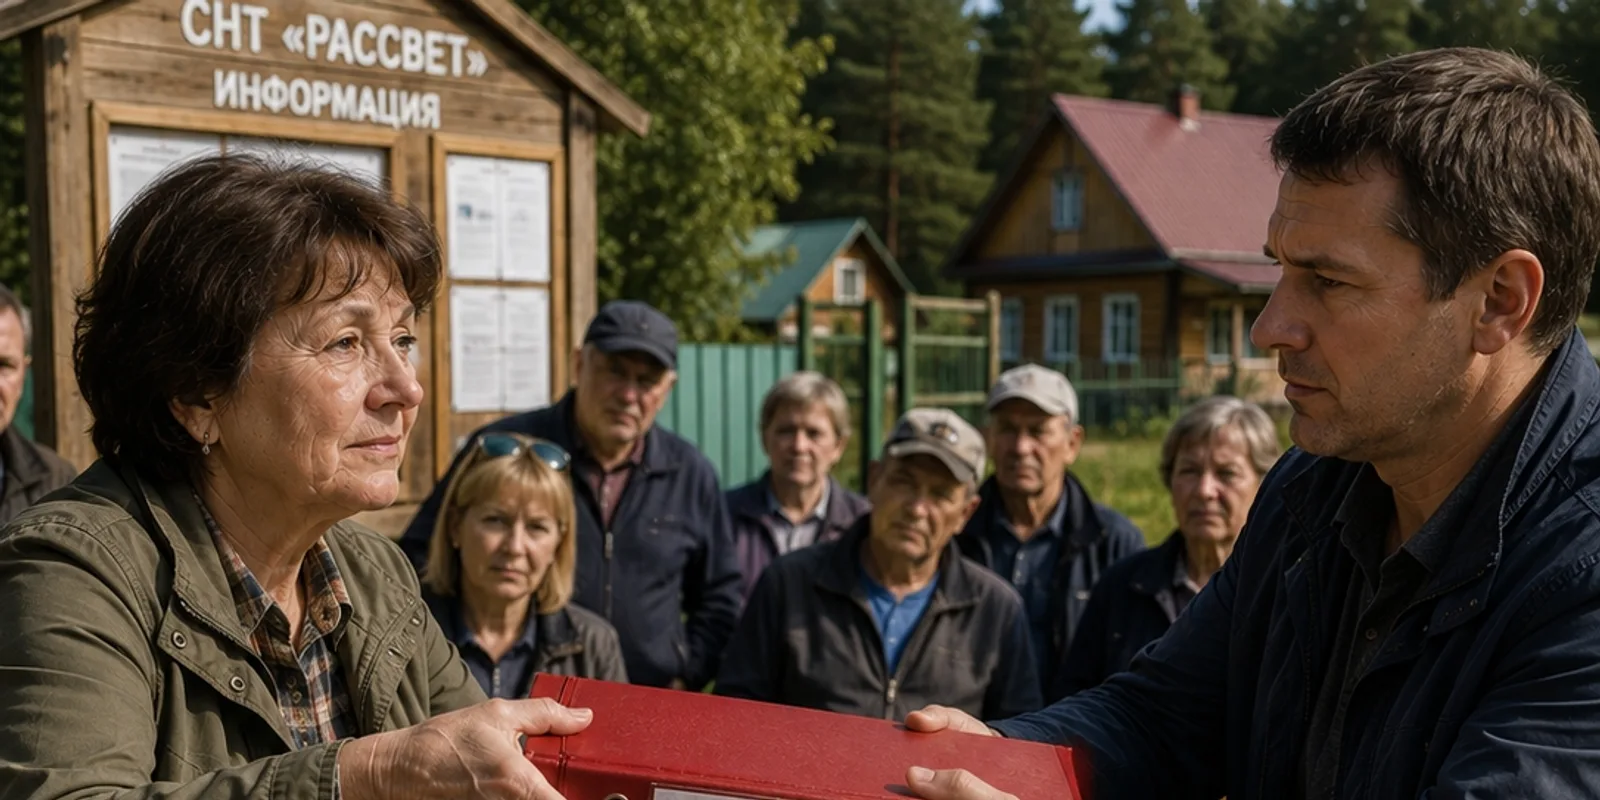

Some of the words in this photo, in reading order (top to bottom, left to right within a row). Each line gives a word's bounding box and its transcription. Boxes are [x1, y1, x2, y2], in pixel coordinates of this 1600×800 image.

[181, 0, 269, 53] СНТ
[282, 13, 488, 77] «РАССВЕТ»
[213, 68, 441, 130] ИНФОРМАЦИЯ
